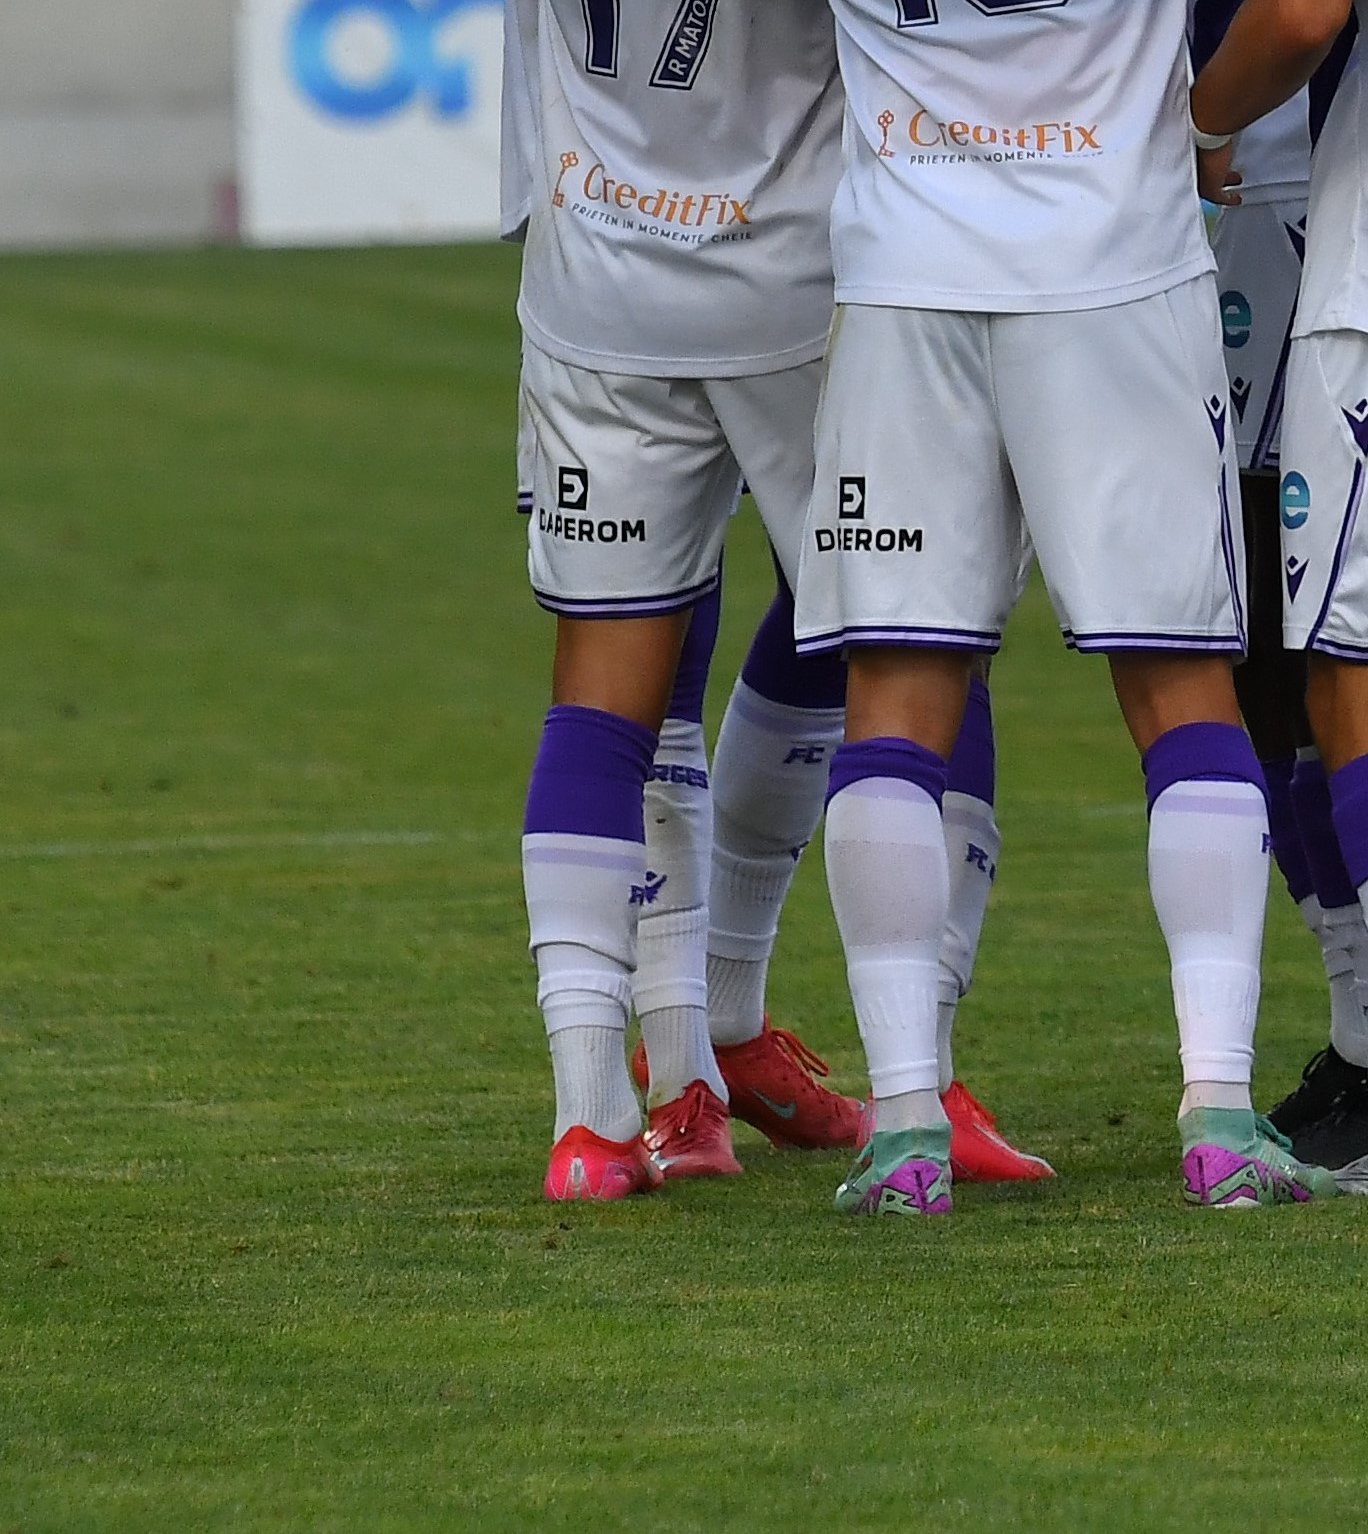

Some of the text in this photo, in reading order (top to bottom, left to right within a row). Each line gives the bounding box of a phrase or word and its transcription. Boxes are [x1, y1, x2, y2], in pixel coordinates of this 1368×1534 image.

[583, 162, 754, 227] CreditFix
[621, 217, 635, 230] IN
[539, 507, 646, 543] DAPEROM
